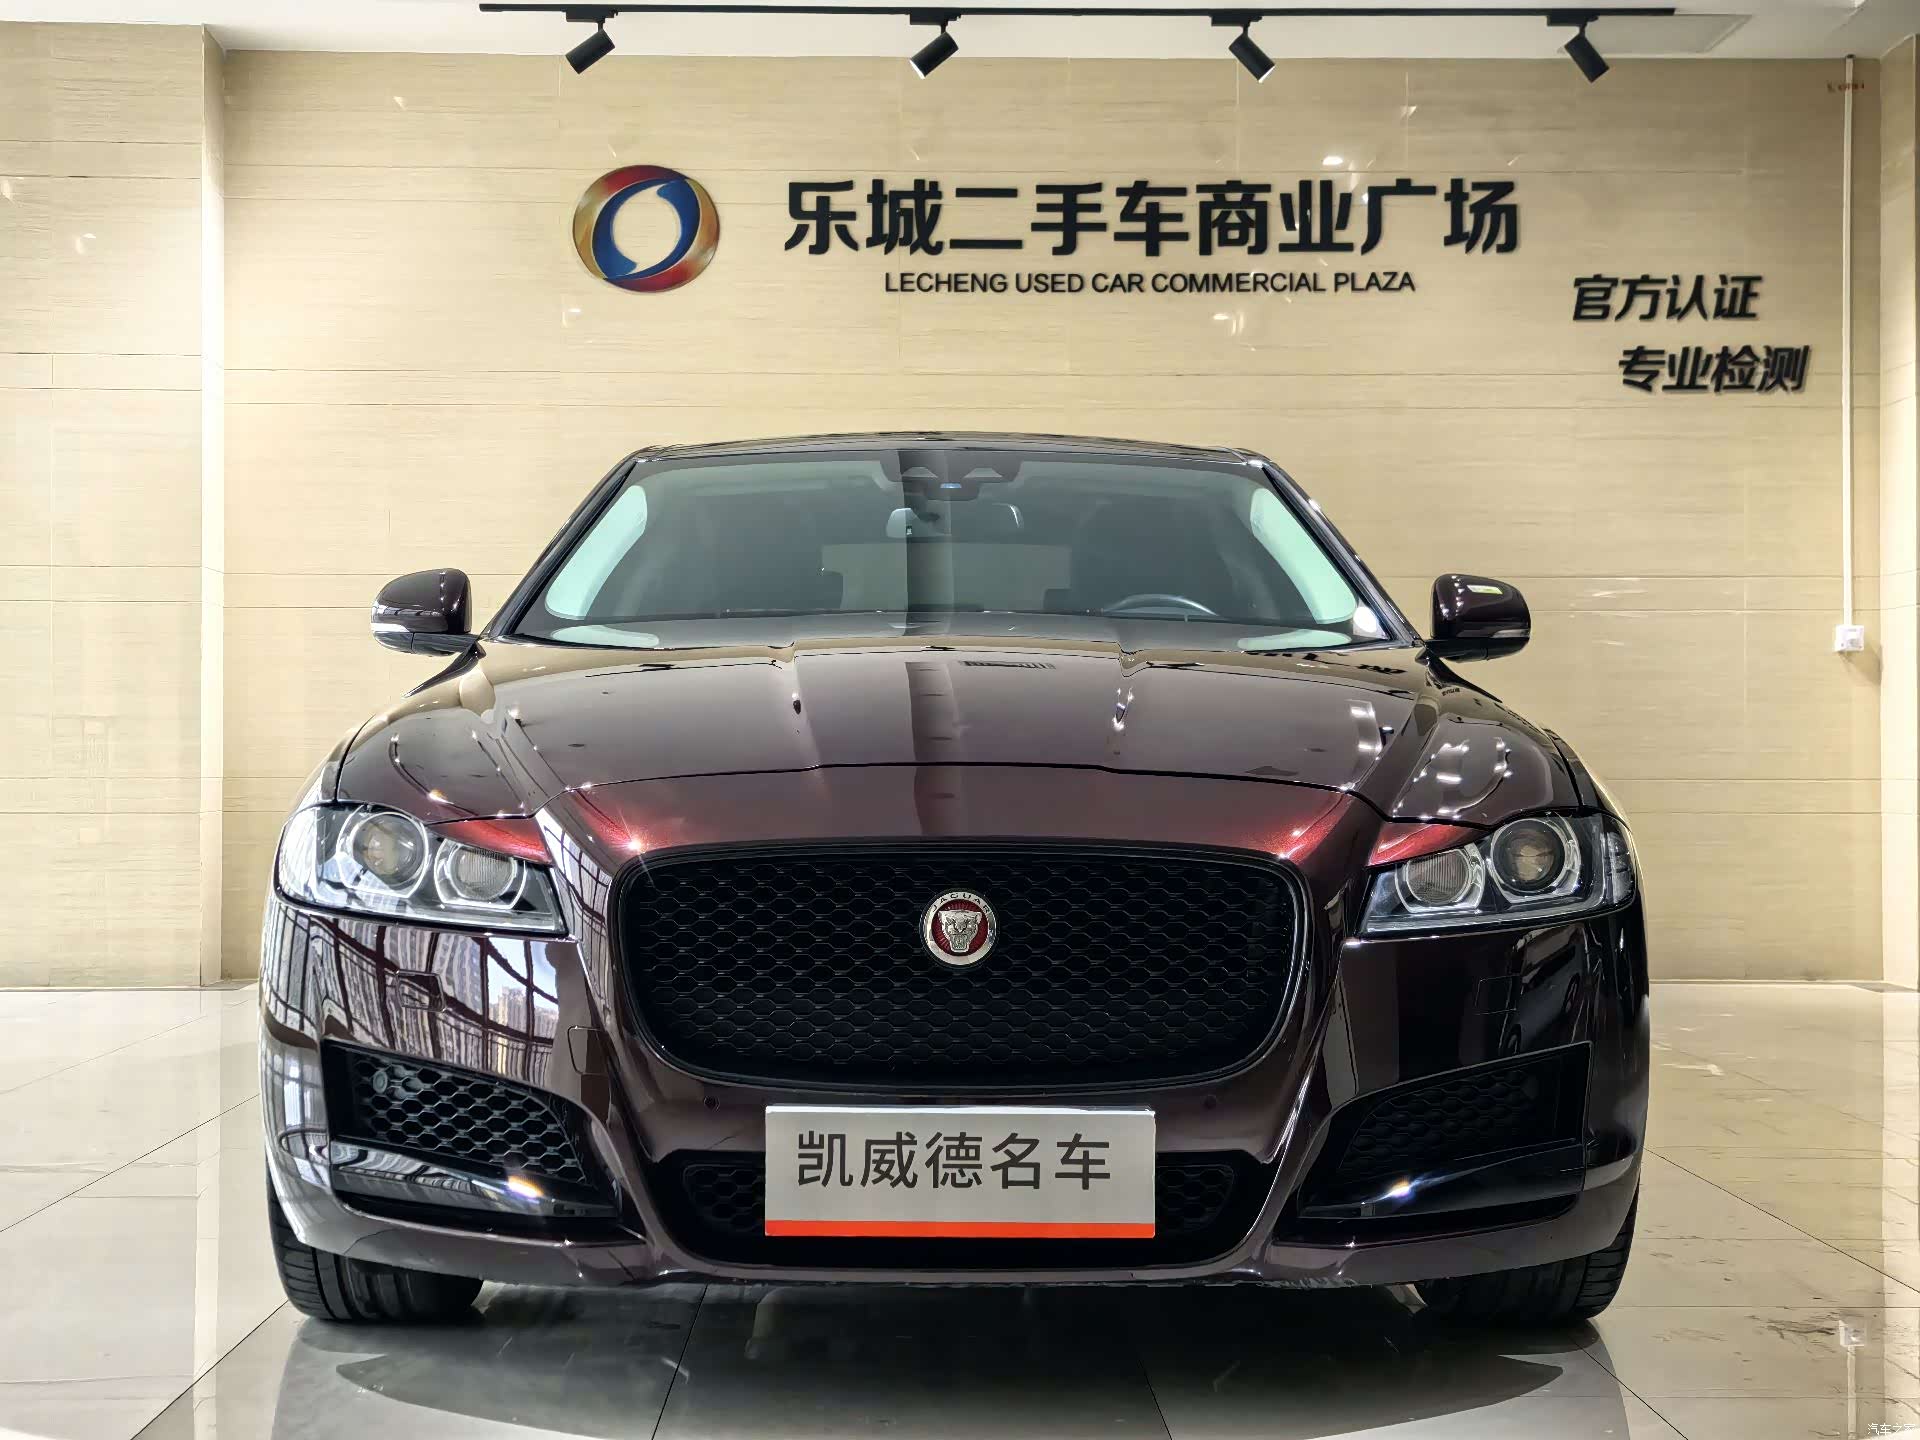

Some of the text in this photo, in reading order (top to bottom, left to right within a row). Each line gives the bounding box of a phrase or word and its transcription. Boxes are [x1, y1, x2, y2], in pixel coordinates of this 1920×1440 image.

[784, 178, 1519, 257] 乐城二手车商业广场
[885, 272, 1416, 294] LECHENG USED CAR COMMERCIAL PLAZA
[1572, 273, 1764, 321] 官方认证
[1618, 345, 1811, 394] 专业检测
[930, 892, 991, 914] JAGUAR
[797, 1130, 1111, 1191] 凯威德名车
